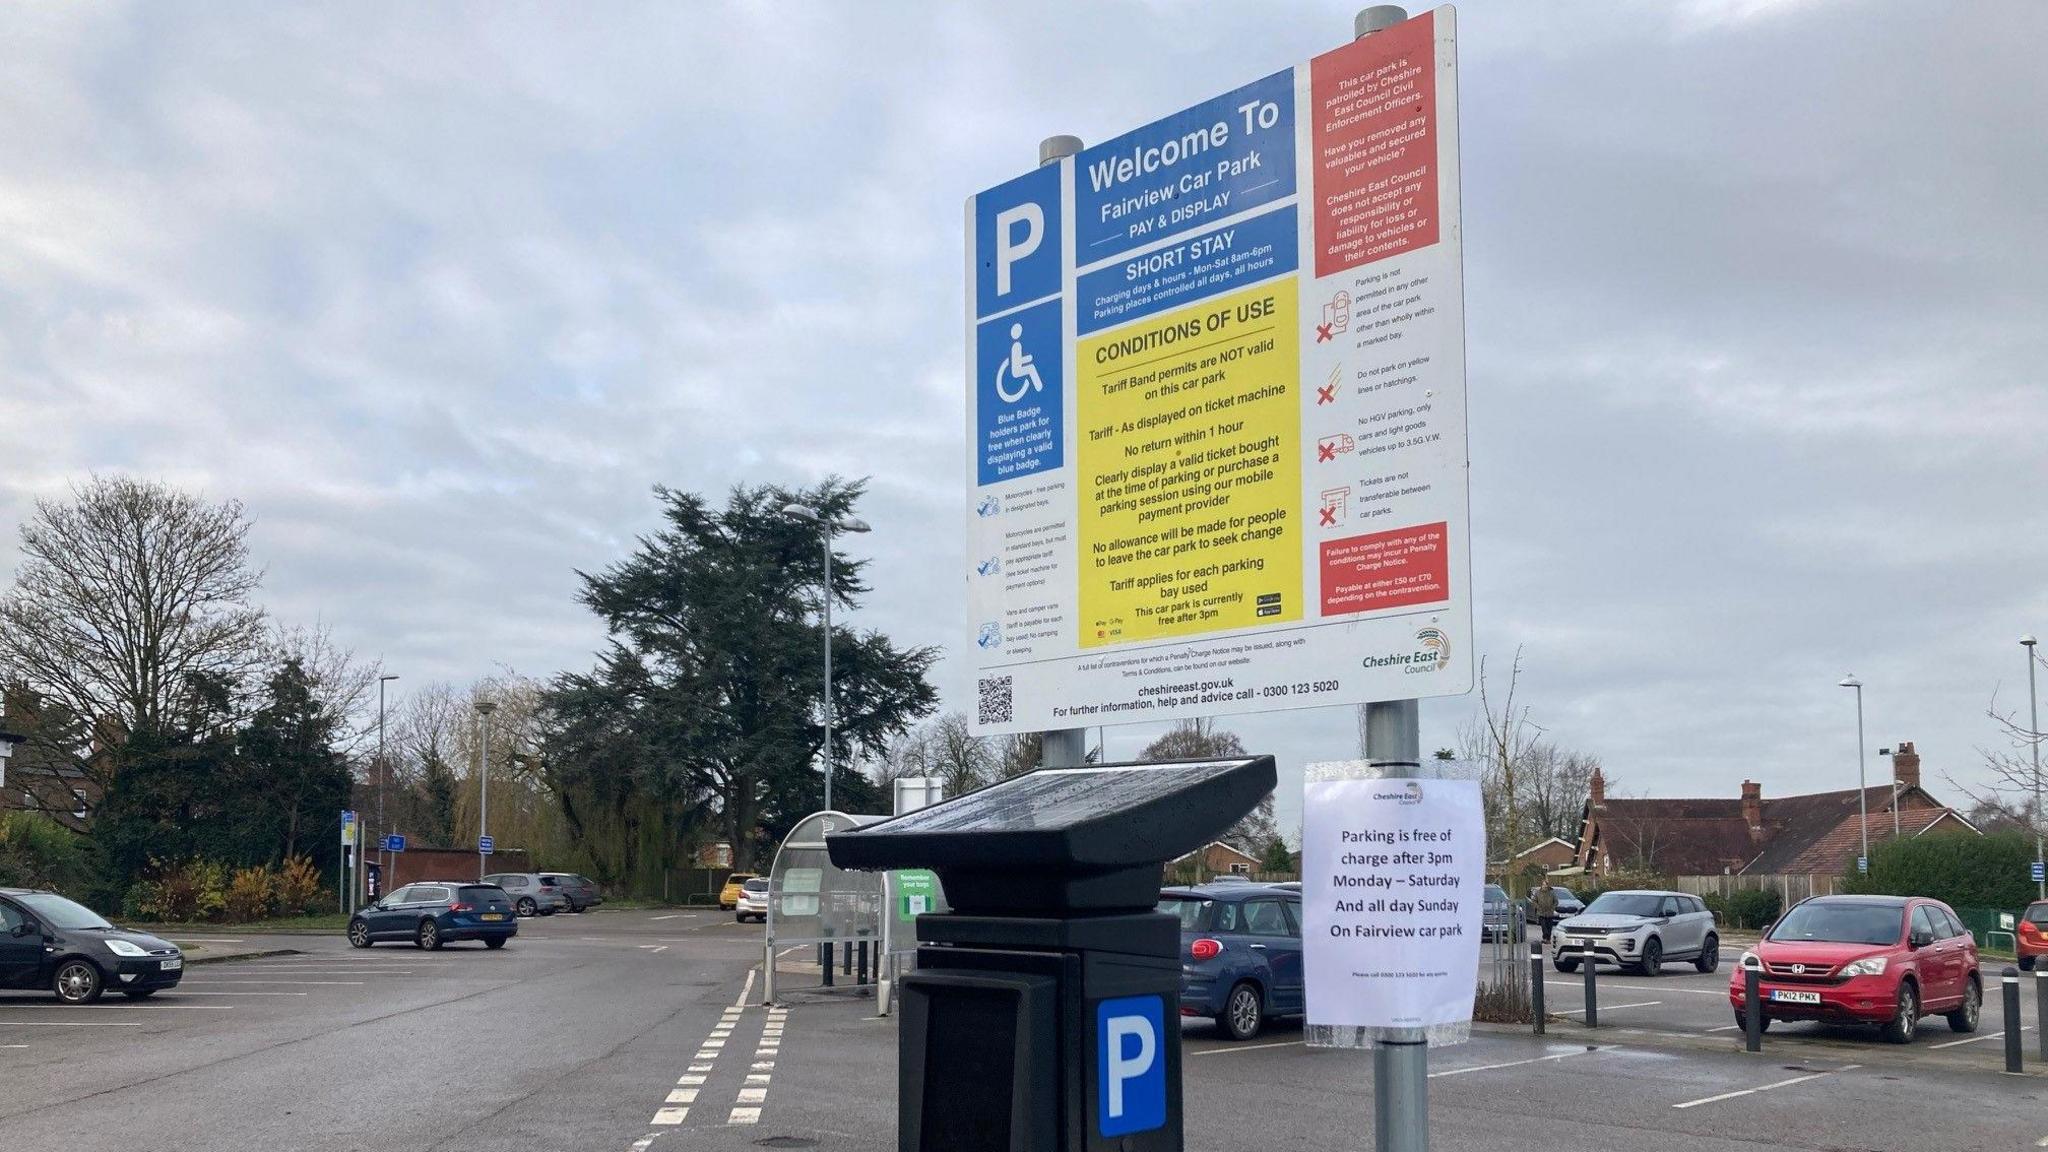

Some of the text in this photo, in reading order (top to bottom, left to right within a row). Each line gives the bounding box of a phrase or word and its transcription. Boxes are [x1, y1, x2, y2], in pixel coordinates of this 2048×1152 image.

[1326, 66, 1422, 109] patrolled by Cheshire
[1339, 59, 1408, 90] This car park is
[1334, 80, 1414, 116] East Council Civil
[1326, 92, 1424, 132] Enforcement Officers.
[1089, 99, 1279, 192] Welcome To
[1102, 150, 1261, 222] Fairview Car Park
[1130, 191, 1230, 238] PAY & DISPLAY
[997, 202, 1044, 296] P
[1127, 230, 1234, 280] SHORT STAY
[1094, 257, 1274, 319] Parking places controlled all days, all hours
[1096, 290, 1131, 306] Charging
[1132, 283, 1152, 294] days
[1154, 279, 1160, 287] &
[1162, 272, 1186, 285] hours
[1194, 257, 1229, 274] Mon-Sat
[1231, 244, 1272, 263] 8am-6pm
[1096, 297, 1275, 364] CONDITIONS OF USE
[1102, 338, 1274, 395] Tariff Band permits are NOT valid
[1381, 364, 1396, 375] park
[1408, 357, 1430, 368] yellow
[1145, 370, 1225, 400] on this car park
[990, 417, 1051, 438] holders park for
[998, 407, 1041, 424] Blue Badge
[988, 429, 1051, 452] free when clearly
[988, 441, 1052, 464] displaying a valid
[1125, 421, 1244, 457] No return within 1 hour
[998, 457, 1042, 474] blue badge.
[1360, 478, 1383, 486] Tickets
[1360, 485, 1431, 502] transferable between
[1093, 508, 1286, 553] No allowance will be made for people
[1110, 558, 1264, 591] Tariff applies for each parking
[1336, 584, 1363, 594] Payable
[1419, 572, 1432, 581] £70
[1135, 592, 1243, 617] This car park is currently
[1158, 610, 1218, 625] free after 3pm
[1363, 651, 1438, 668] Cheshire East
[1404, 663, 1438, 674] Council
[1053, 708, 1068, 716] For
[1070, 705, 1099, 715] further
[1101, 700, 1155, 712] information,
[1158, 697, 1178, 708] help
[1180, 694, 1198, 705] and
[1201, 692, 1233, 703] advice
[1236, 688, 1254, 700] call
[1263, 685, 1288, 697] 0300
[1292, 683, 1310, 694] 123
[1313, 680, 1339, 692] 5020
[1138, 678, 1234, 696] cheshireeast.gov.uk
[1342, 828, 1451, 844] Parking is free of
[1341, 851, 1452, 867] charge after 3pm
[1333, 874, 1392, 889] Monday
[1408, 874, 1460, 888] Saturday
[1335, 898, 1458, 914] And all day Sunday
[1330, 923, 1462, 938] On Fairview car park
[1107, 1015, 1156, 1118] P
